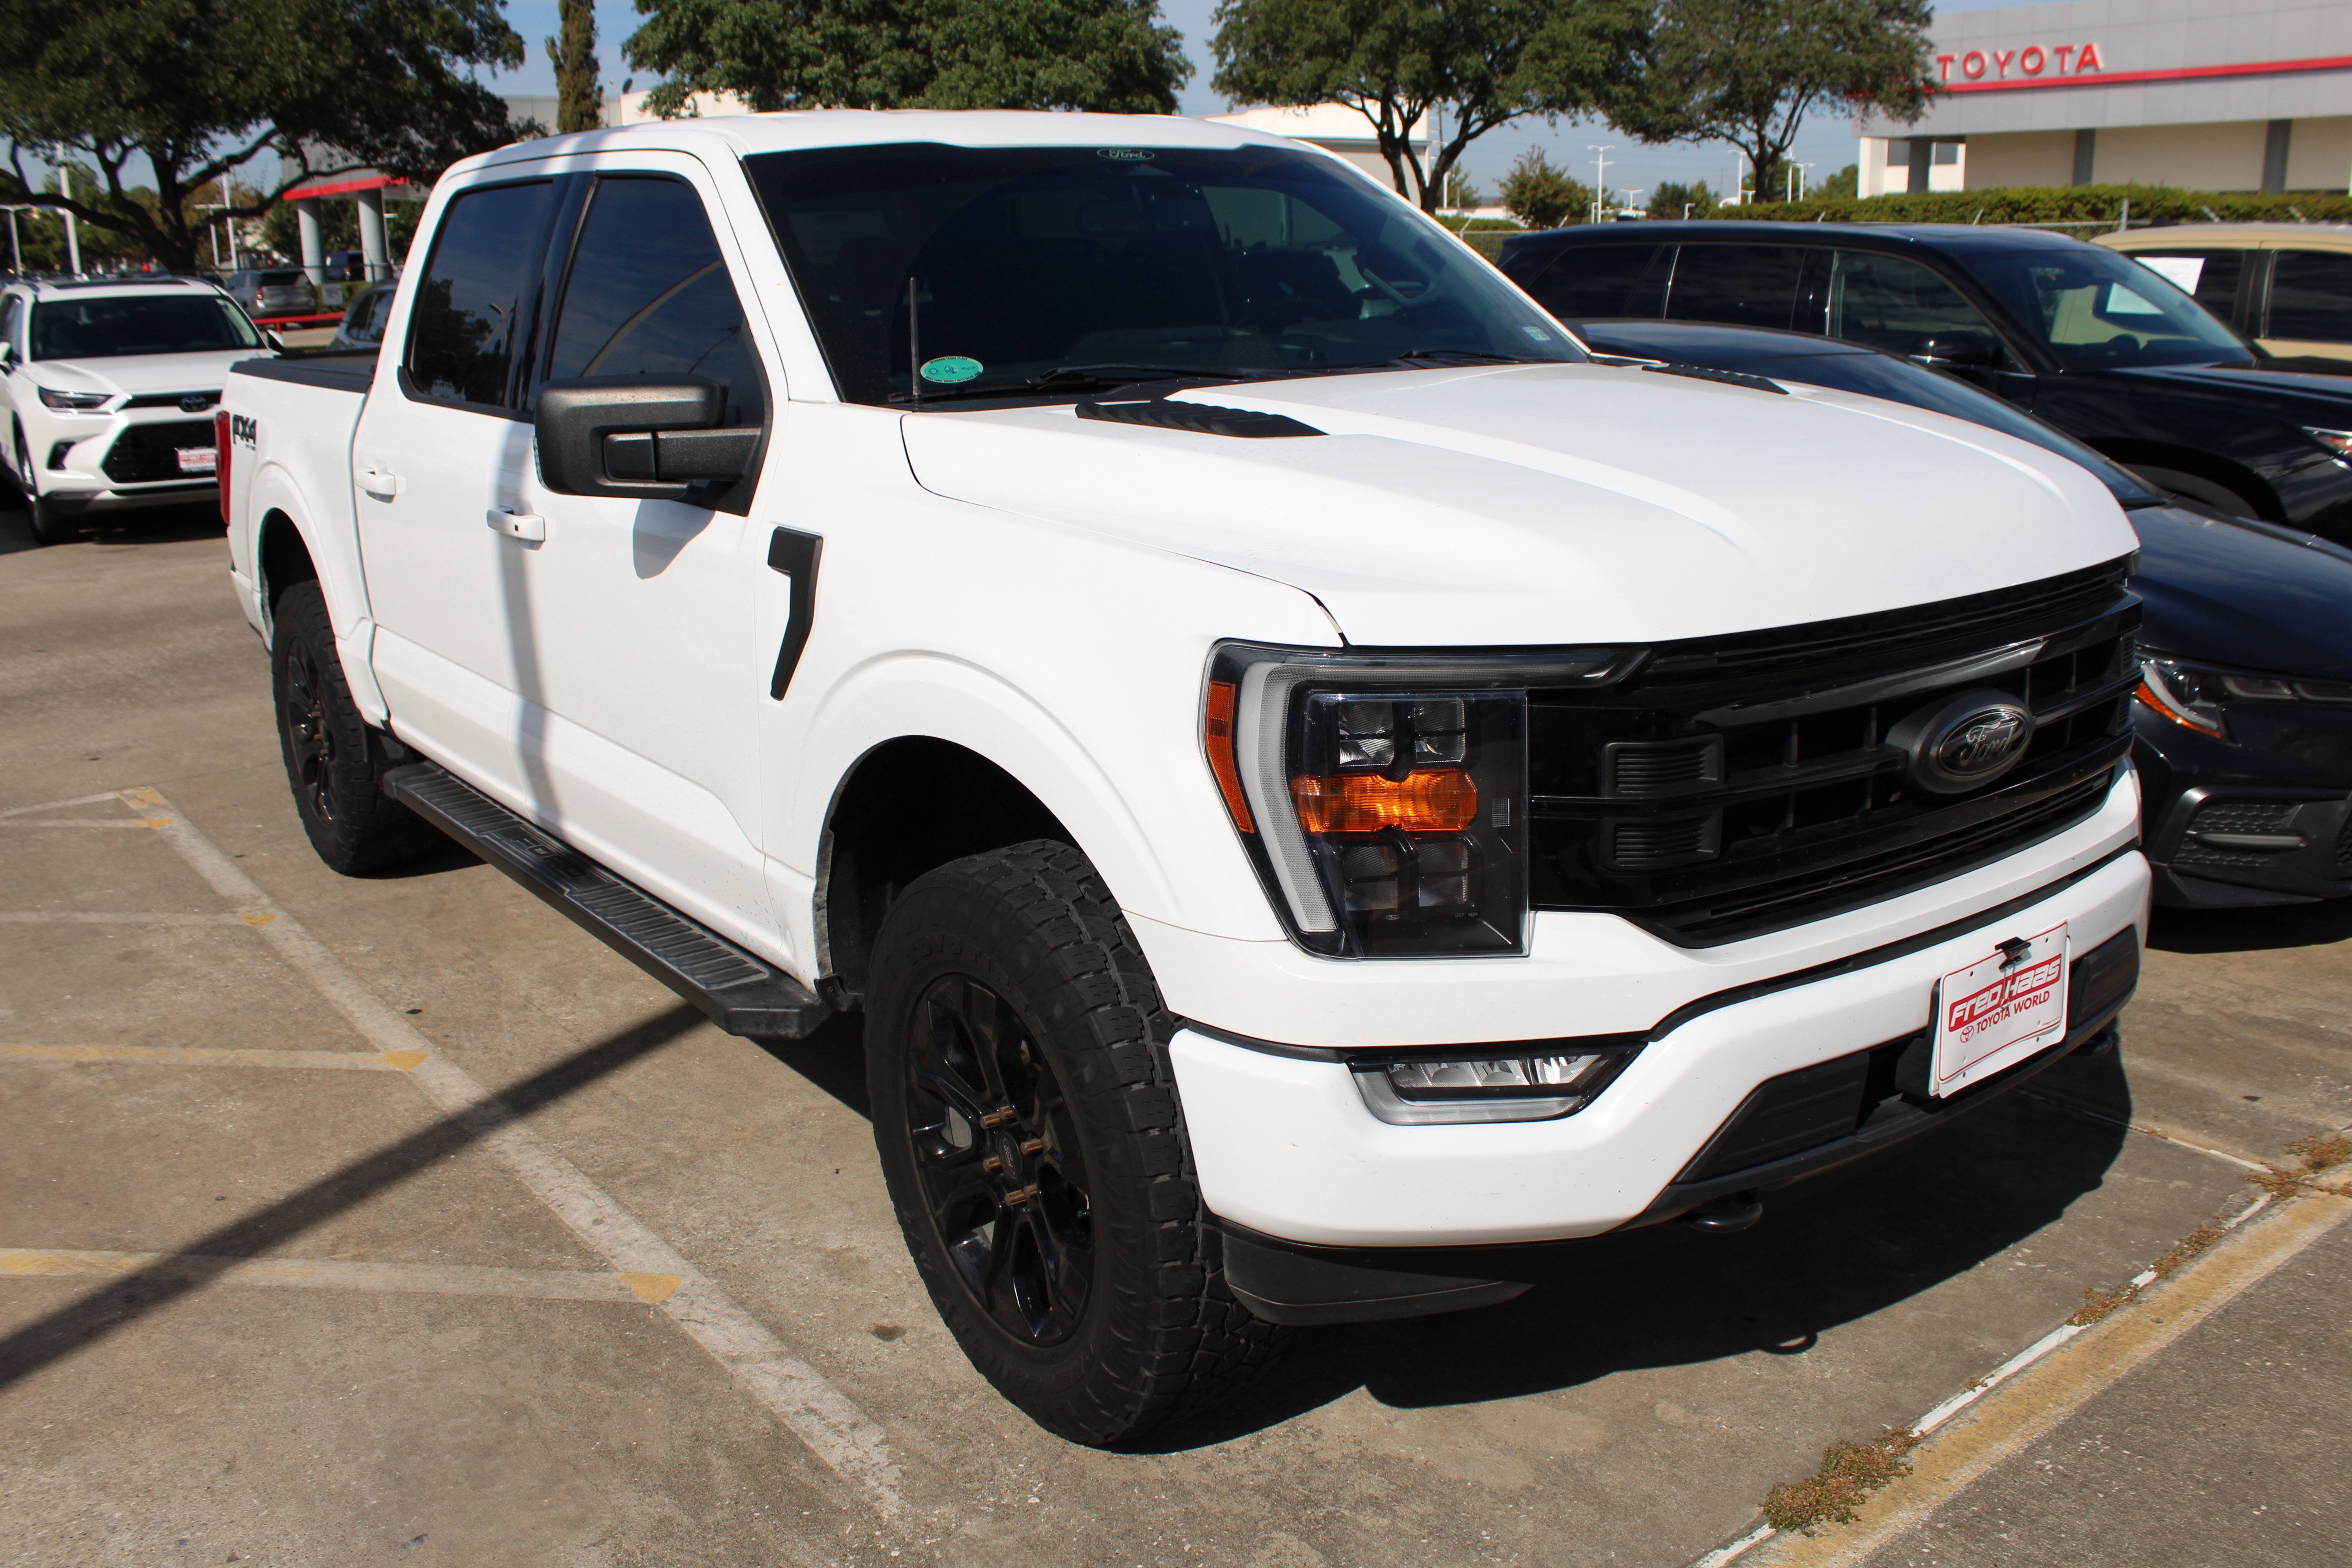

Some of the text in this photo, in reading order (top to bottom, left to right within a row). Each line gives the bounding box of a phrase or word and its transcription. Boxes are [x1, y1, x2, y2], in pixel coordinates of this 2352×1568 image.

[1936, 42, 2105, 81] TOYOTA
[1960, 714, 2020, 767] Ford
[513, 836, 588, 878] FORD
[1977, 990, 2050, 1034] TOYOTA WORLD
